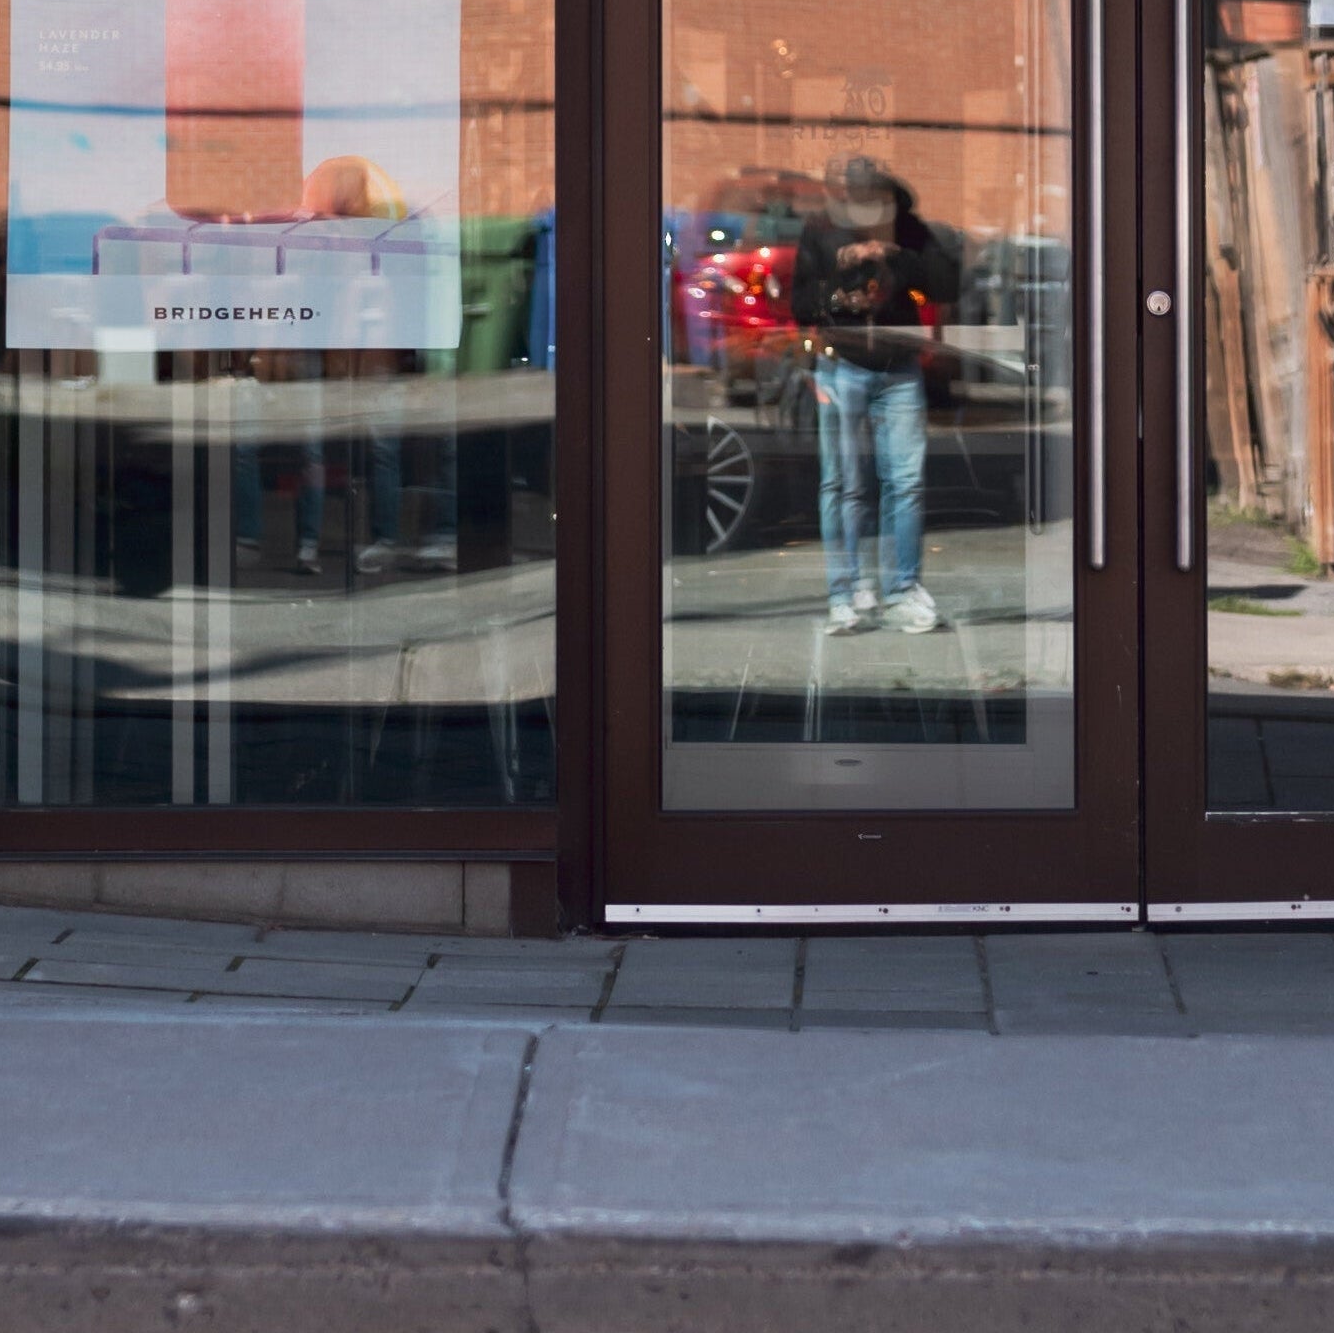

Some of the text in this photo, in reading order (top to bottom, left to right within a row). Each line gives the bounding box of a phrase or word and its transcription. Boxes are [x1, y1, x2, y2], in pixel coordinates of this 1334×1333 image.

[38, 29, 121, 41] LAVENDER
[38, 43, 80, 54] HAZE
[153, 307, 314, 321] BRIDGEHEAD
